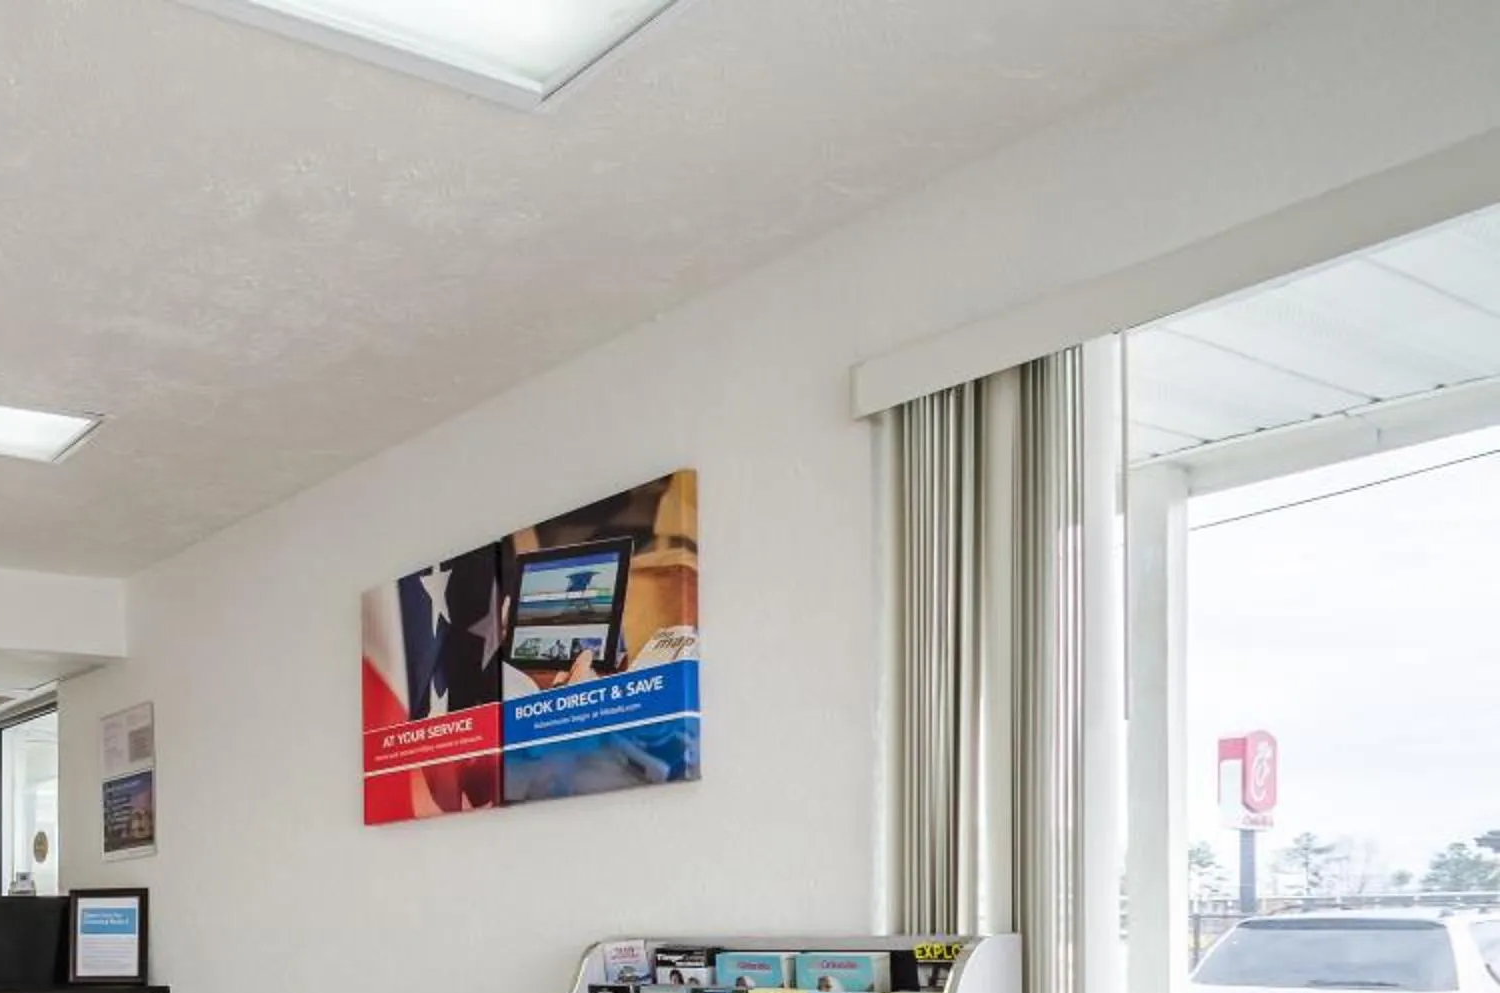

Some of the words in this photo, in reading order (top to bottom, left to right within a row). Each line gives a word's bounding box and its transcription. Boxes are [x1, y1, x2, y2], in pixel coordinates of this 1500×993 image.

[515, 700, 553, 720] BOOK
[556, 688, 607, 710] DIRECT
[611, 685, 624, 699] &
[626, 675, 664, 696] SAVE
[383, 735, 396, 748] AT
[398, 729, 425, 745] YOUR
[427, 717, 474, 739] SERVICE
